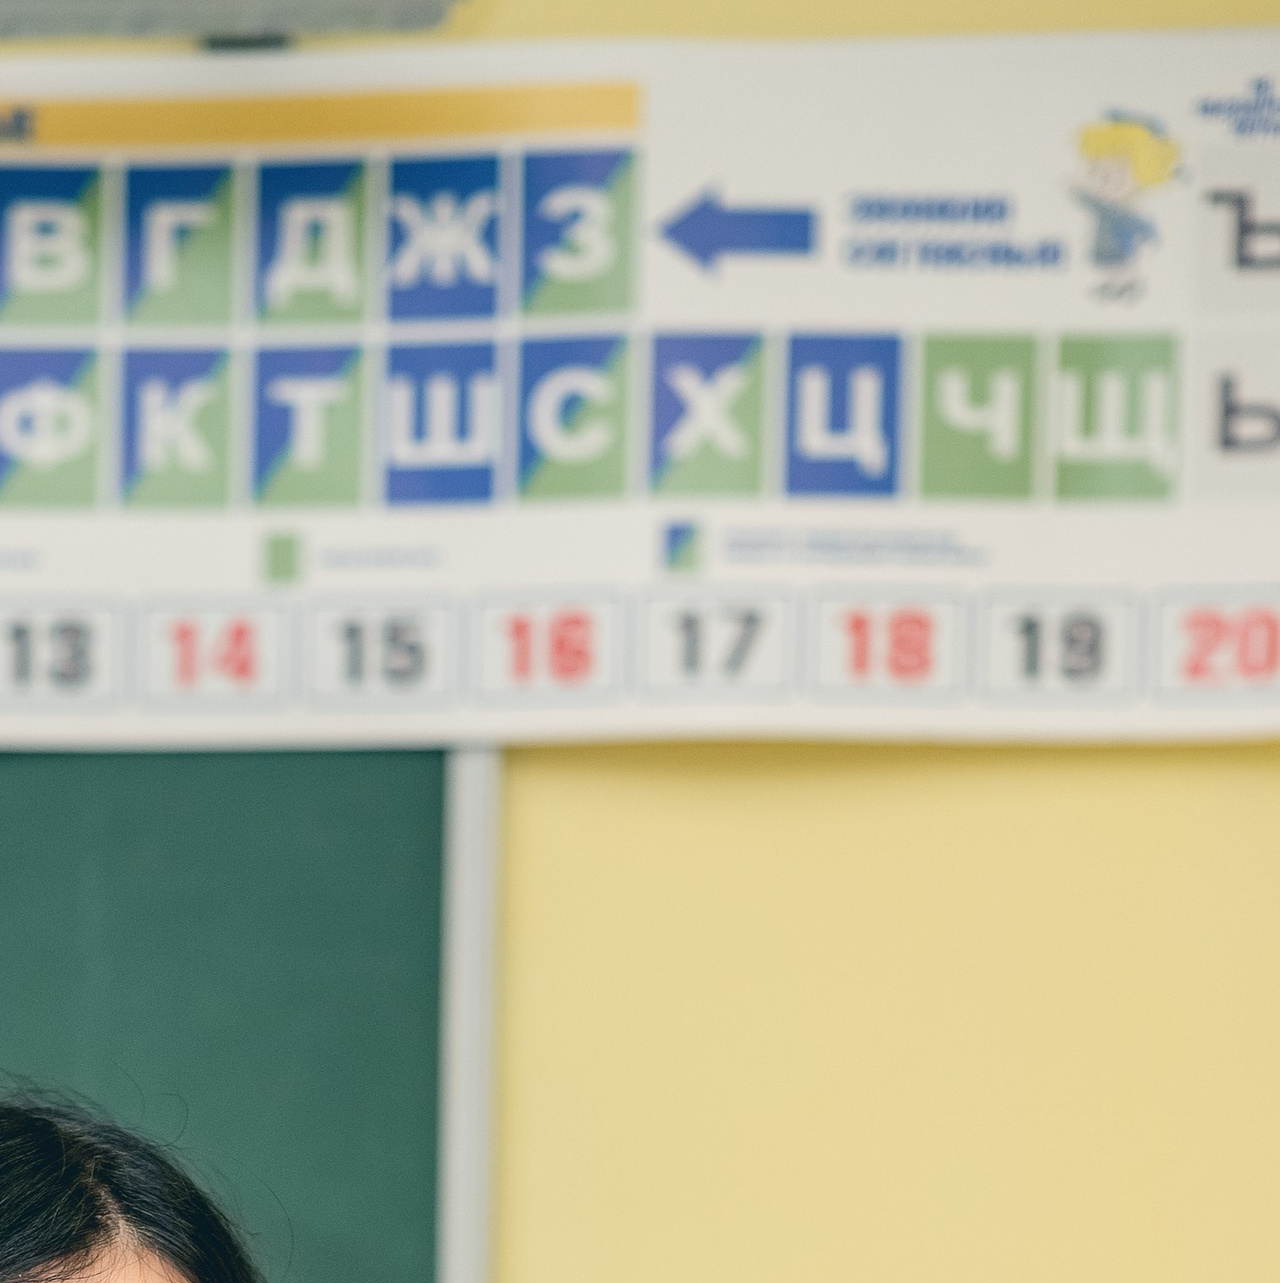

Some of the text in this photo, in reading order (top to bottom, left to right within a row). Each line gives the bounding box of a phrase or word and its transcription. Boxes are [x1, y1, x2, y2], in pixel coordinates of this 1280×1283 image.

[7, 203, 89, 292] В
[147, 204, 211, 294] Г
[266, 200, 356, 306] Д
[394, 195, 496, 287] Ж
[538, 186, 613, 280] З
[143, 380, 211, 470] К
[273, 380, 354, 468] Т
[390, 376, 496, 466] Ш
[529, 367, 612, 462] С
[667, 369, 749, 461] Х
[796, 367, 888, 478] Ц
[939, 369, 1019, 461] Ч
[1063, 373, 1175, 482] Щ
[9, 620, 92, 688] 13
[171, 620, 256, 686] 14
[340, 619, 426, 684] 15
[505, 613, 594, 684] 16
[679, 612, 763, 679] 17
[848, 610, 934, 682] 18
[1015, 613, 1103, 681] 19
[1184, 612, 1280, 684] 20
